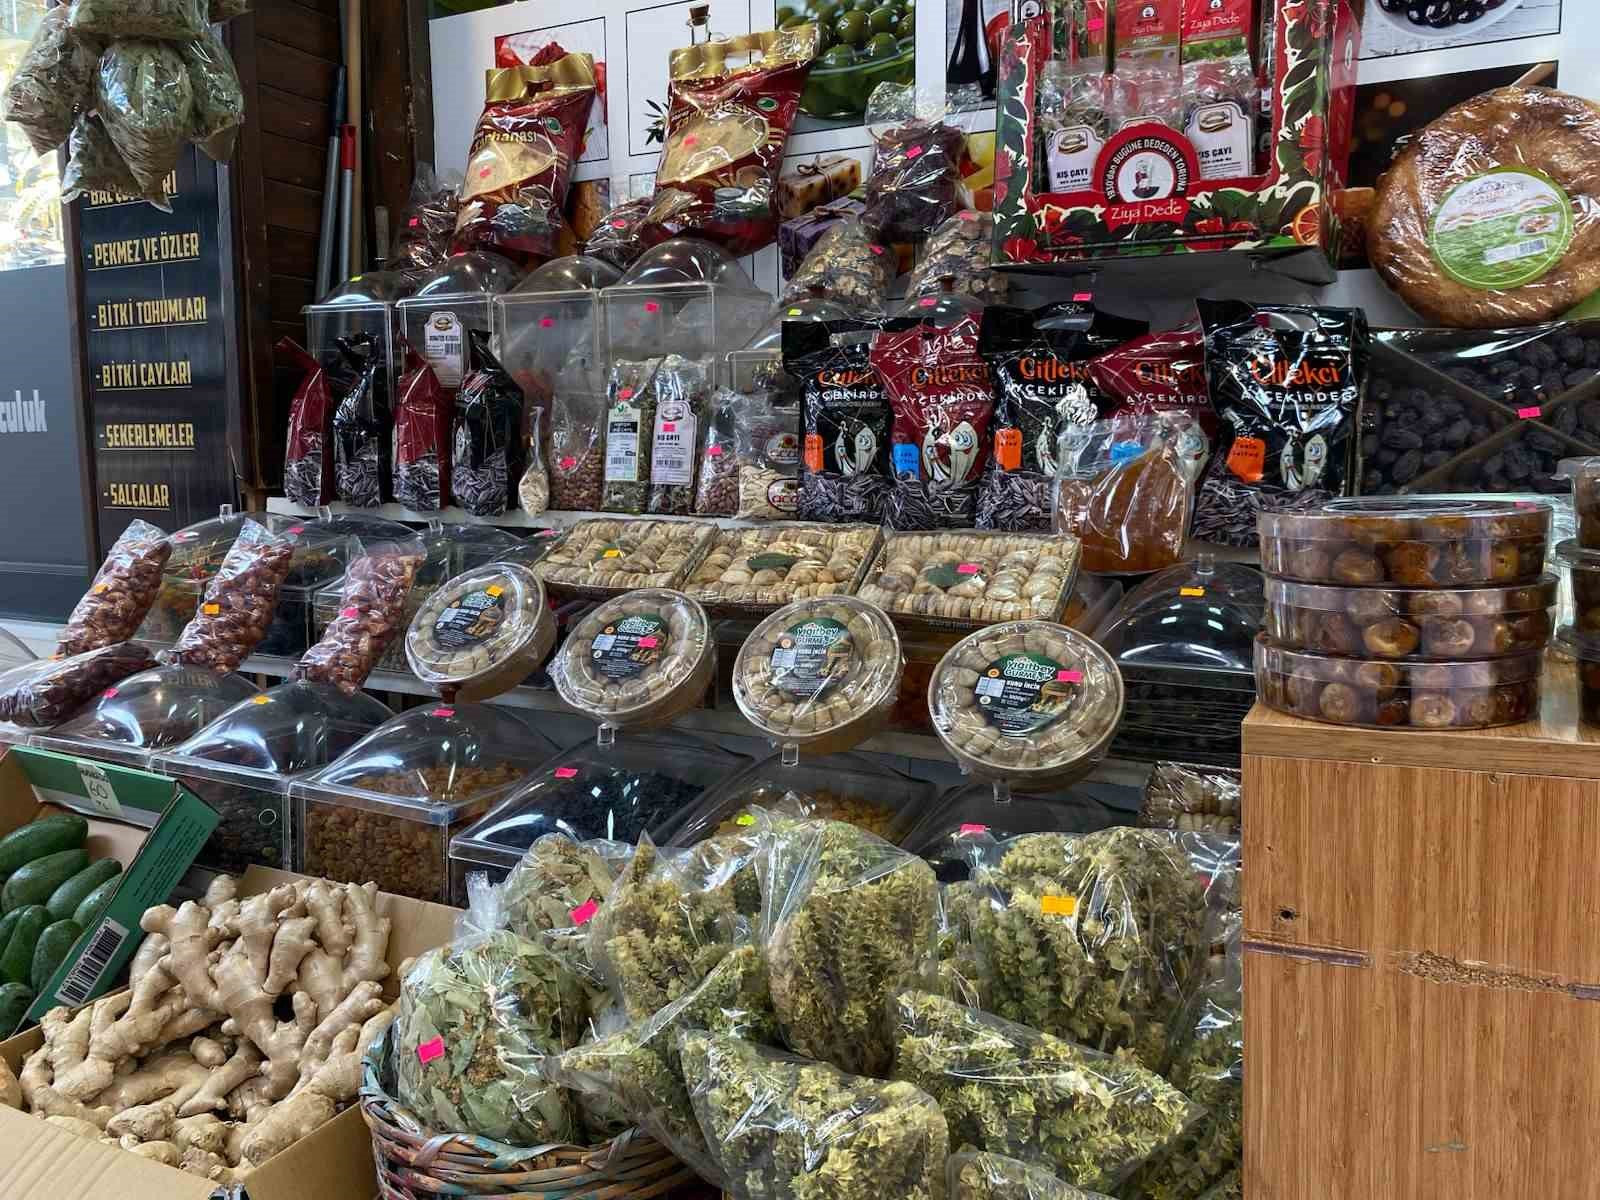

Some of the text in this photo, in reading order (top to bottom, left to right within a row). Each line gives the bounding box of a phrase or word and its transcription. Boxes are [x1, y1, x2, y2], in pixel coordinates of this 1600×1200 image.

[1111, 199, 1182, 224] Ziya Dede
[94, 231, 199, 266] PEKMEZ VE ÖZLER
[98, 296, 207, 327] BİTKİ TOHUMLARI
[103, 360, 192, 387] BİTKİ ÇAYLARI
[110, 484, 169, 507] SALÇALAR
